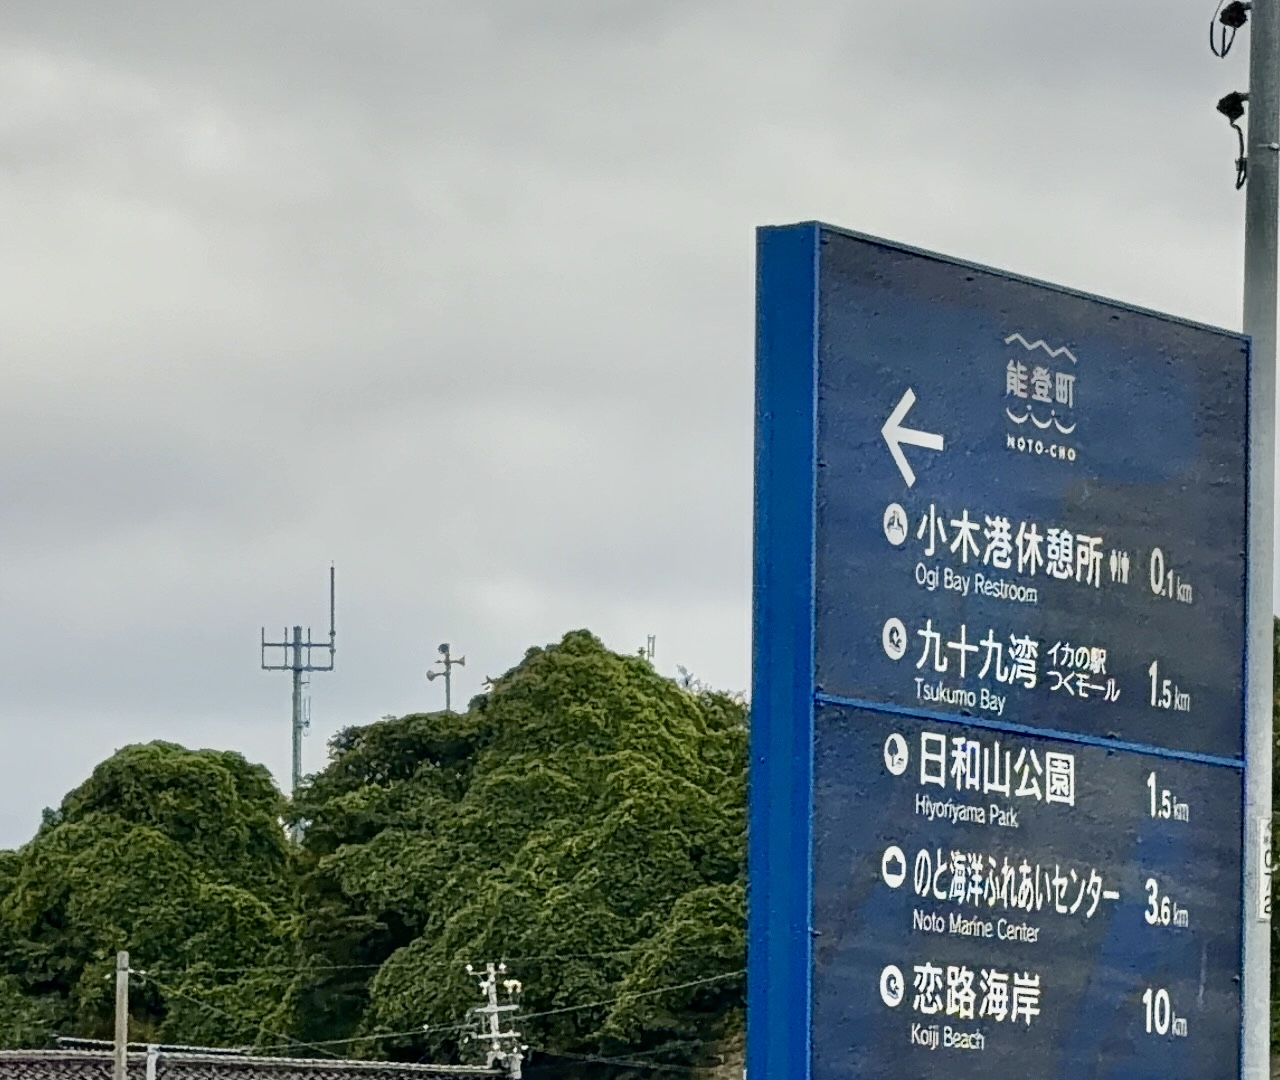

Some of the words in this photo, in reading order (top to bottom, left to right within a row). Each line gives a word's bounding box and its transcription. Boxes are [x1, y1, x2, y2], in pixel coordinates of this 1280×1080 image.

[1006, 359, 1076, 408] 能登町
[1006, 433, 1077, 461] NOTO-CHO
[916, 503, 1104, 589] 小木港休憩所
[915, 562, 939, 591] Ogi
[944, 570, 970, 596] Bay
[974, 573, 1038, 604] Restroom
[915, 618, 1040, 689] 九十九湾
[1046, 641, 1107, 675] イカの駅
[914, 677, 976, 708] Tsukumo
[980, 689, 1007, 716] Bay
[1046, 671, 1122, 703] つくモール
[919, 731, 1076, 807] 日和山公園
[915, 793, 986, 826] Hiyoriyama
[989, 804, 1020, 828] Park
[913, 848, 1120, 919] のと海洋ふれあいセンター
[913, 909, 945, 933] Noto
[949, 913, 994, 938] Marine
[997, 918, 1040, 943] Center
[912, 962, 1042, 1026] 恋路海岸
[911, 1022, 939, 1050] Koiji
[943, 1026, 985, 1051] Beach
